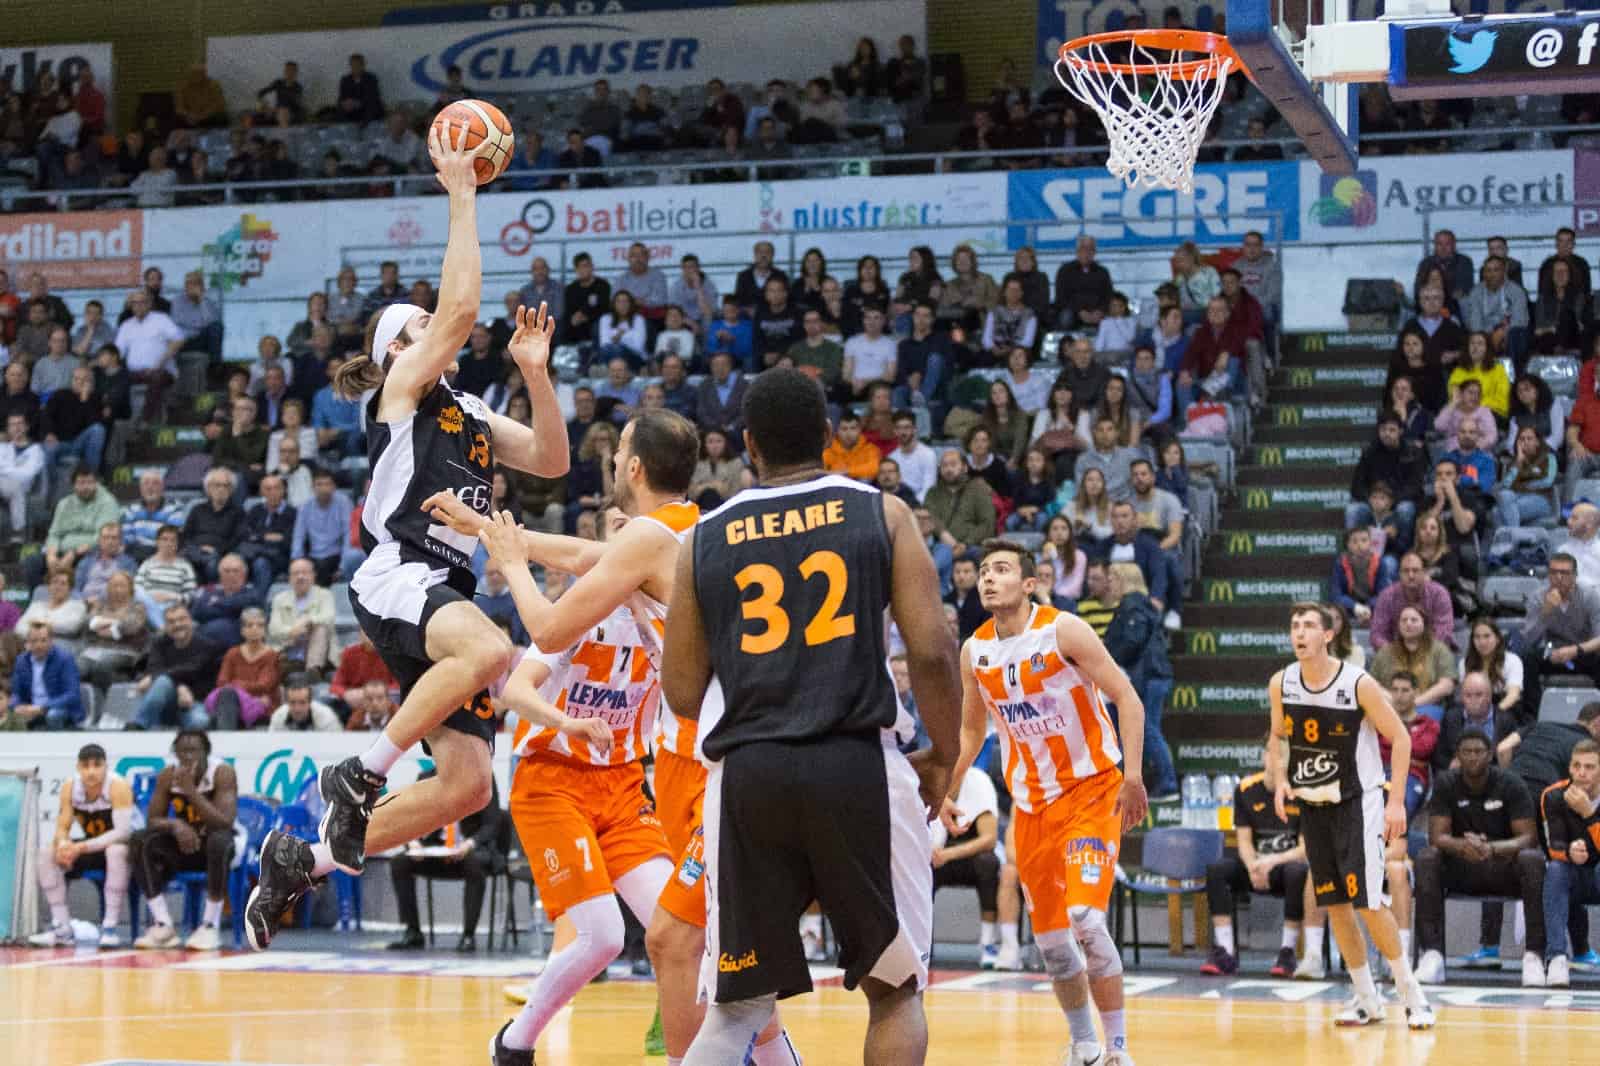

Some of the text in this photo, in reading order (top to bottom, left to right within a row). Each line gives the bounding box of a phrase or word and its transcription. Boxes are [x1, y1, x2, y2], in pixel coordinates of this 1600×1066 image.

[467, 37, 700, 81] CLANSER
[1526, 28, 1564, 68] @
[1037, 170, 1269, 241] SEGRE
[1384, 172, 1565, 214] Agroferti
[566, 198, 718, 234] batlleida
[725, 499, 846, 546] CLEARE
[733, 549, 857, 656] 32
[1236, 581, 1320, 595] McDonald's
[619, 645, 632, 673] 7
[567, 682, 628, 710] LEYMA
[1304, 719, 1319, 743] 8
[575, 837, 593, 872] 7
[1345, 873, 1358, 898] 8
